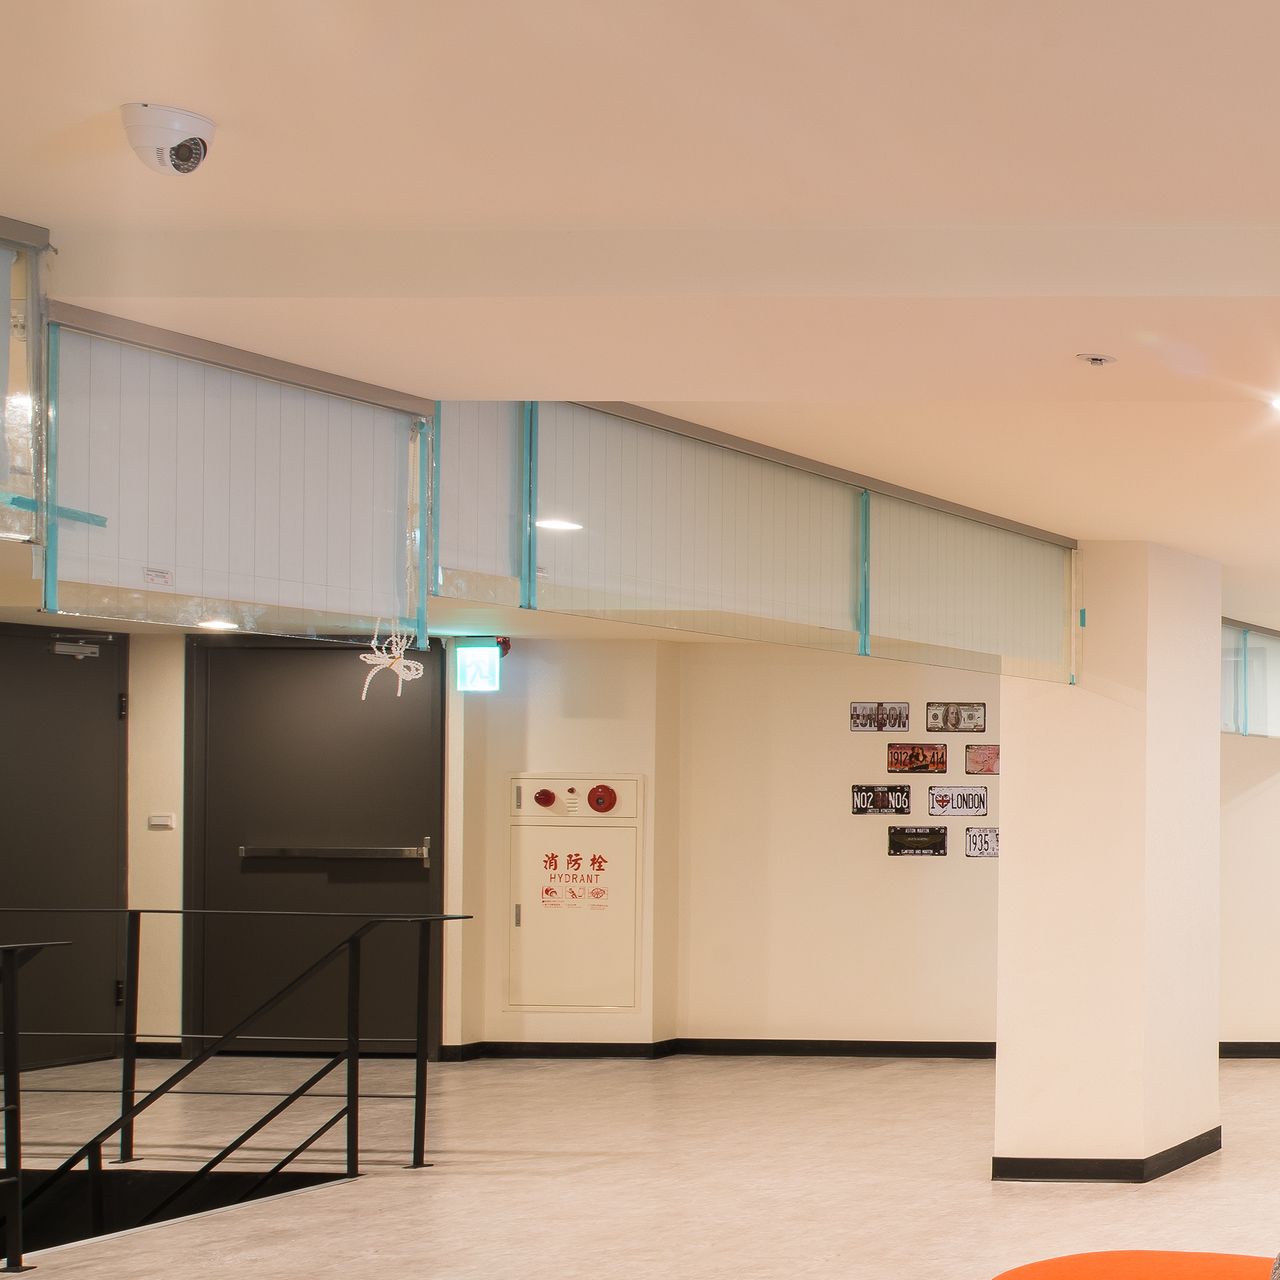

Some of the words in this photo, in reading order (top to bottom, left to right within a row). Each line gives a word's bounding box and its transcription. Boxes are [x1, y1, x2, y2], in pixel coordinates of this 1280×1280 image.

[889, 751, 909, 767] 1912
[930, 751, 945, 768] 414
[931, 793, 935, 809] I
[951, 793, 985, 810] LONDON
[968, 834, 989, 851] 1935
[543, 852, 608, 871] 消防栓
[550, 873, 600, 883] HYDRANT
